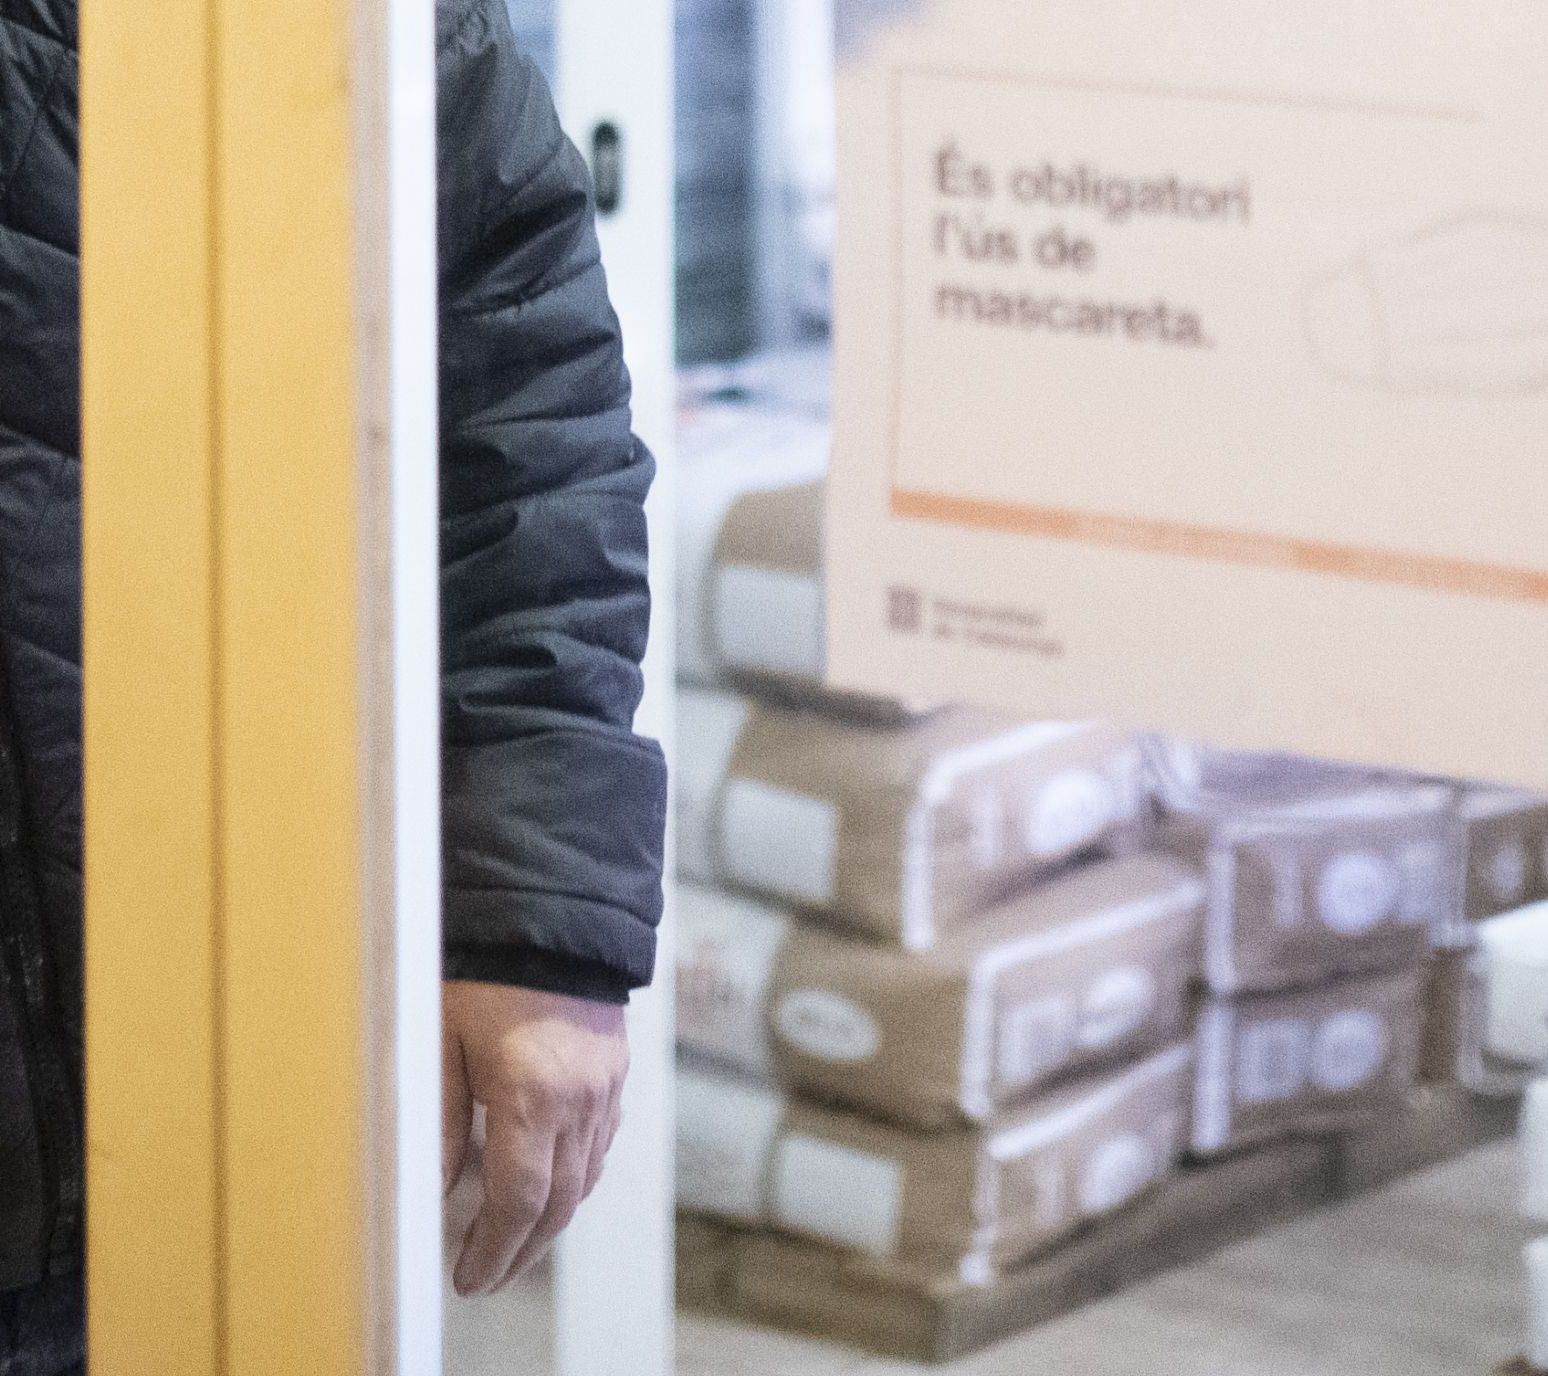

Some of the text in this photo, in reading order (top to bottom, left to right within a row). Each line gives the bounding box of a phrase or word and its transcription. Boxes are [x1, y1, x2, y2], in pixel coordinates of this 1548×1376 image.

[934, 140, 1251, 225] És obligatori
[934, 209, 1097, 273] l'ús de
[934, 281, 1217, 350] mascareta.
